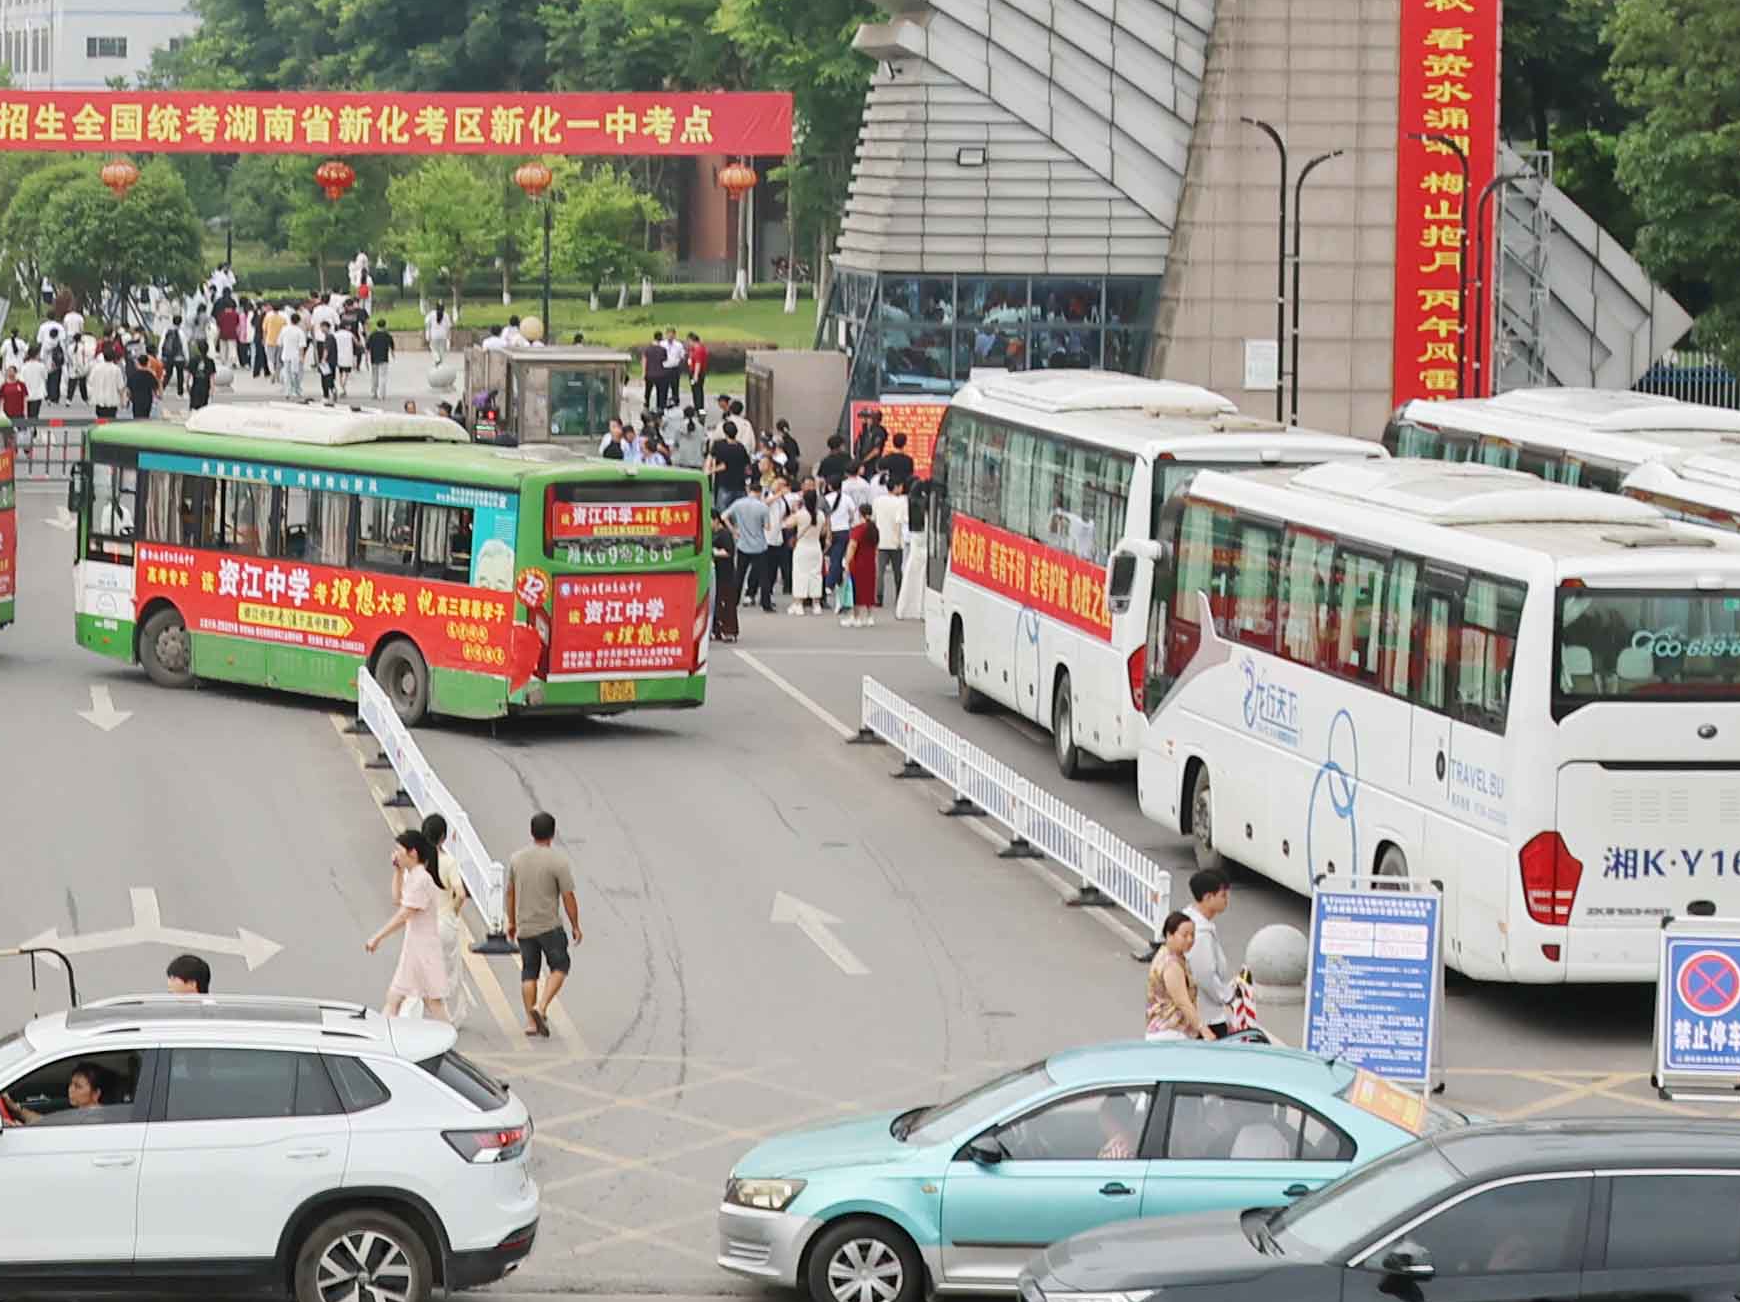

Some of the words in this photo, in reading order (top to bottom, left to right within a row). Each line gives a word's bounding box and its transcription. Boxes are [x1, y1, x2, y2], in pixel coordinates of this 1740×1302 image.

[1419, 171, 1465, 274] 梅山抱月
[1416, 289, 1462, 401] 丙午风雷
[573, 507, 633, 525] 资江中学
[218, 558, 311, 606] 资江中学
[331, 576, 375, 617] 理想
[378, 590, 406, 616] 大学
[584, 597, 665, 624] 资江中学
[618, 624, 655, 646] 理想
